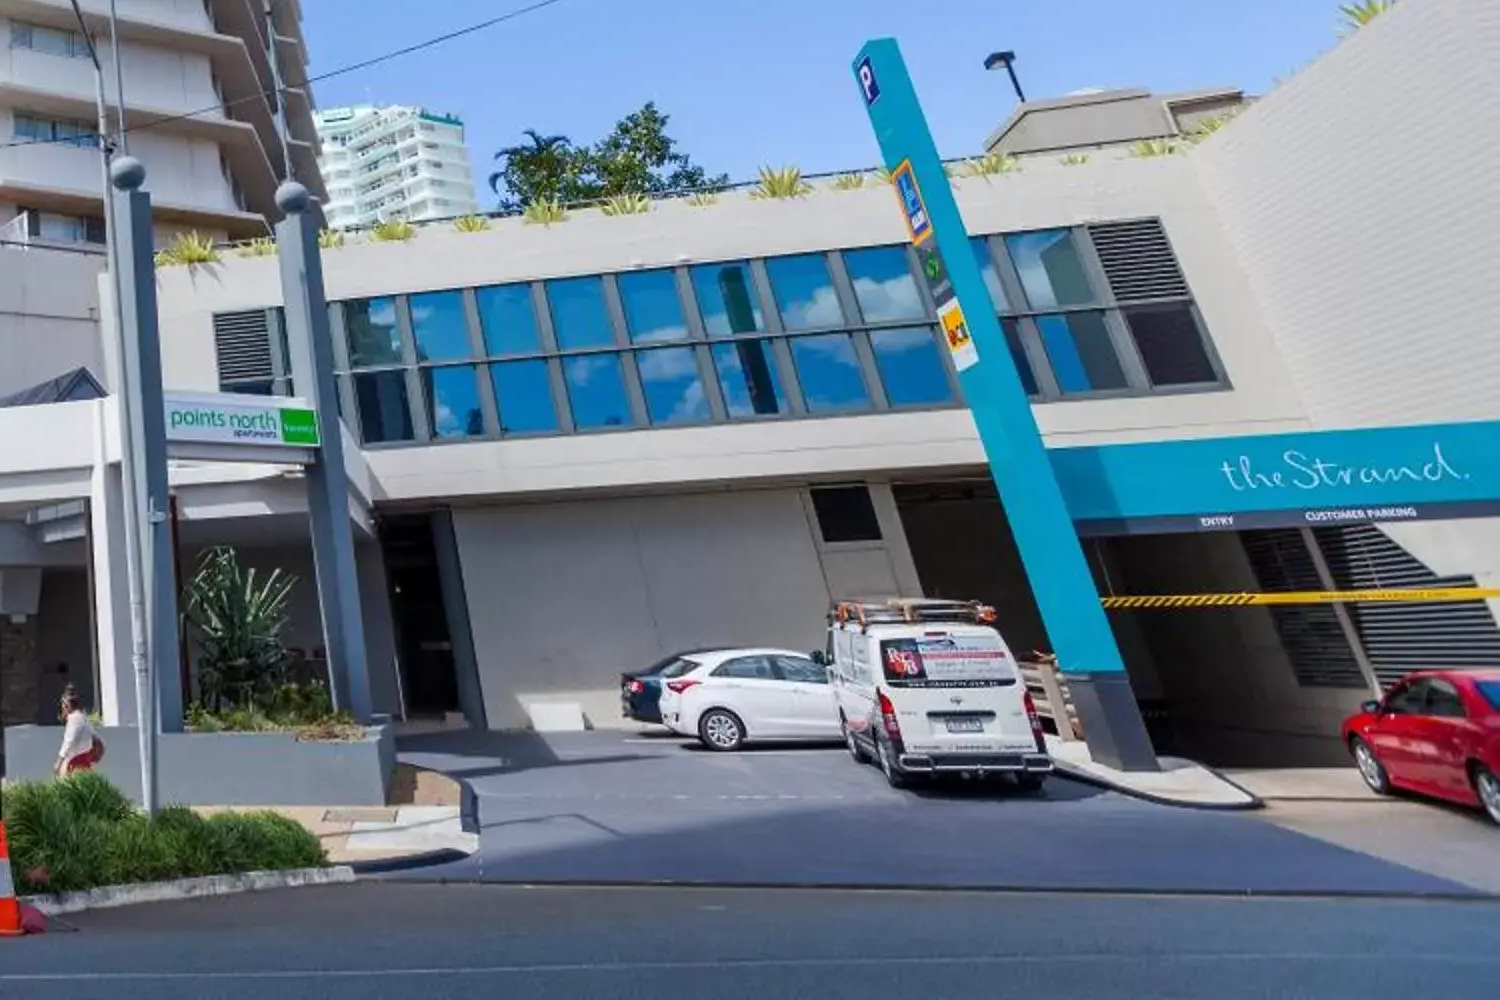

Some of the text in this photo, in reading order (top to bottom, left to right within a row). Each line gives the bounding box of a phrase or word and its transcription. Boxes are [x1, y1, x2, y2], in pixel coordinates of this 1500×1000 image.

[171, 409, 277, 429] points north
[234, 429, 277, 439] apartments
[1305, 506, 1417, 522] CUSTOMER PARKING
[1200, 516, 1234, 527] ENTRY
